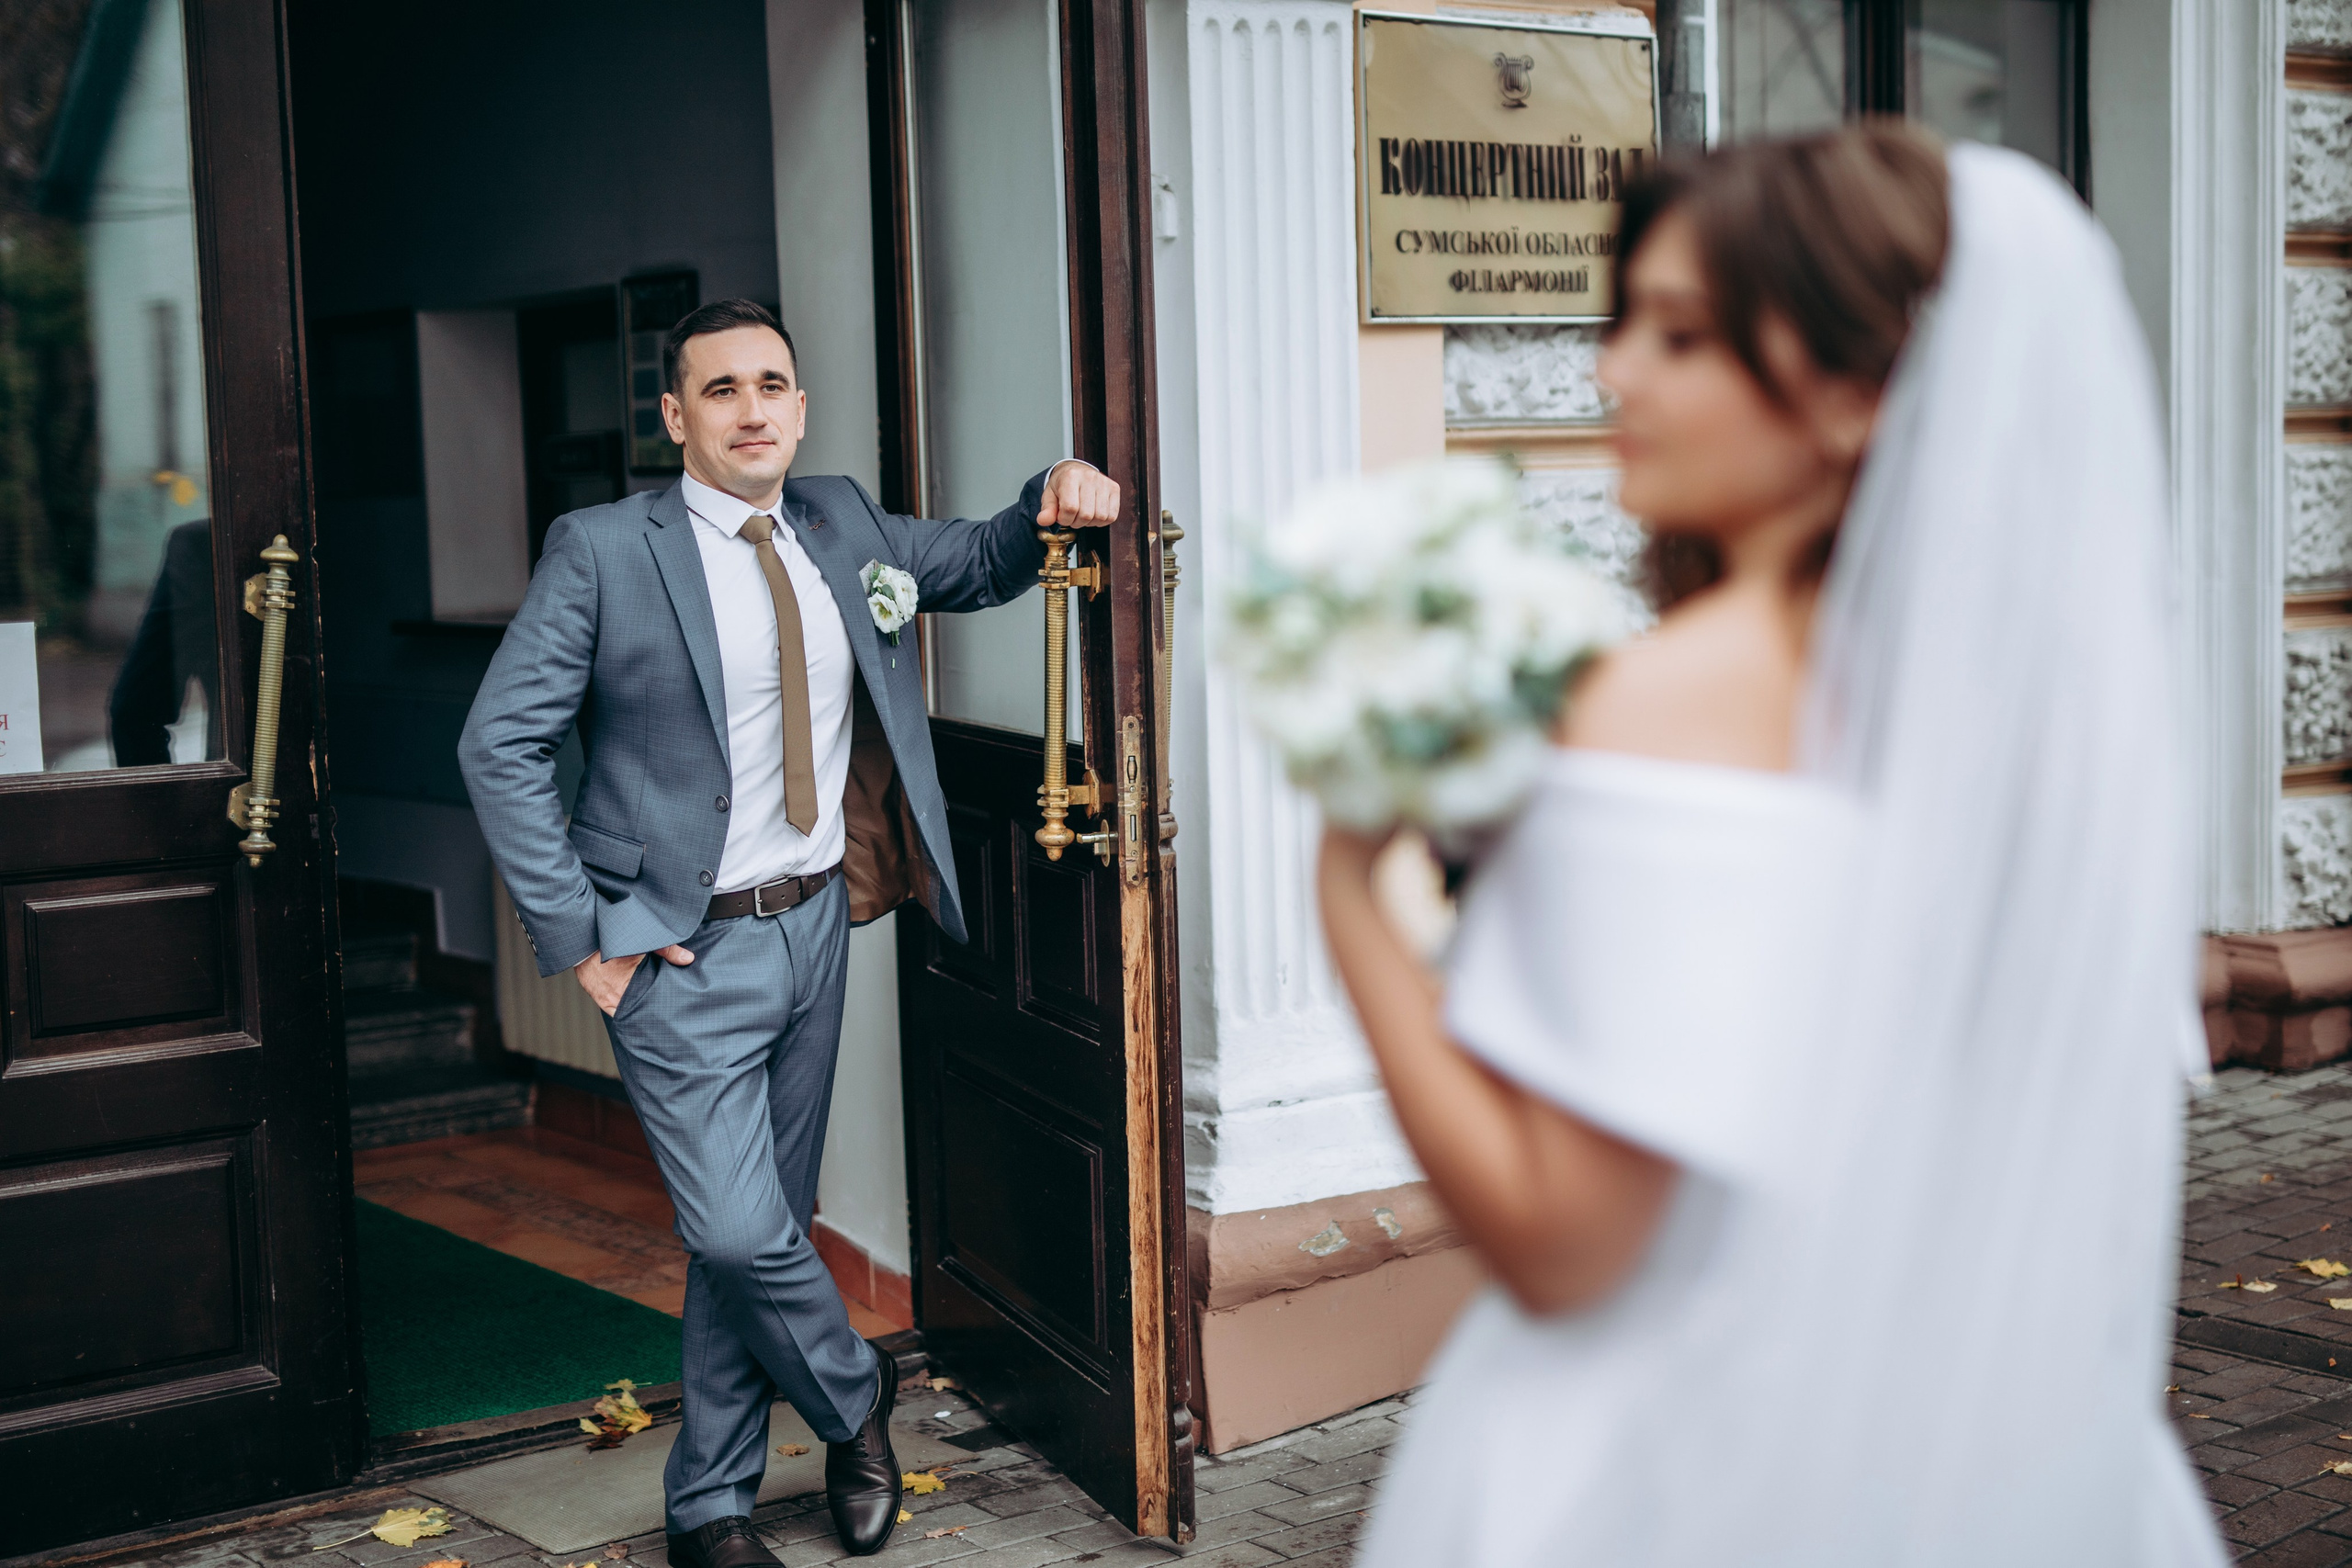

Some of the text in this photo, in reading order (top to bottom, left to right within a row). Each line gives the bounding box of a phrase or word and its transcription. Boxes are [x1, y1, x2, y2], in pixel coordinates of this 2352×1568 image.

[1379, 134, 1587, 204] КОНЦЕРТНИЙ
[1396, 226, 1519, 254] СУМСЬКОЇ
[1449, 265, 1589, 293] ФІЛАРМОНІЇ
